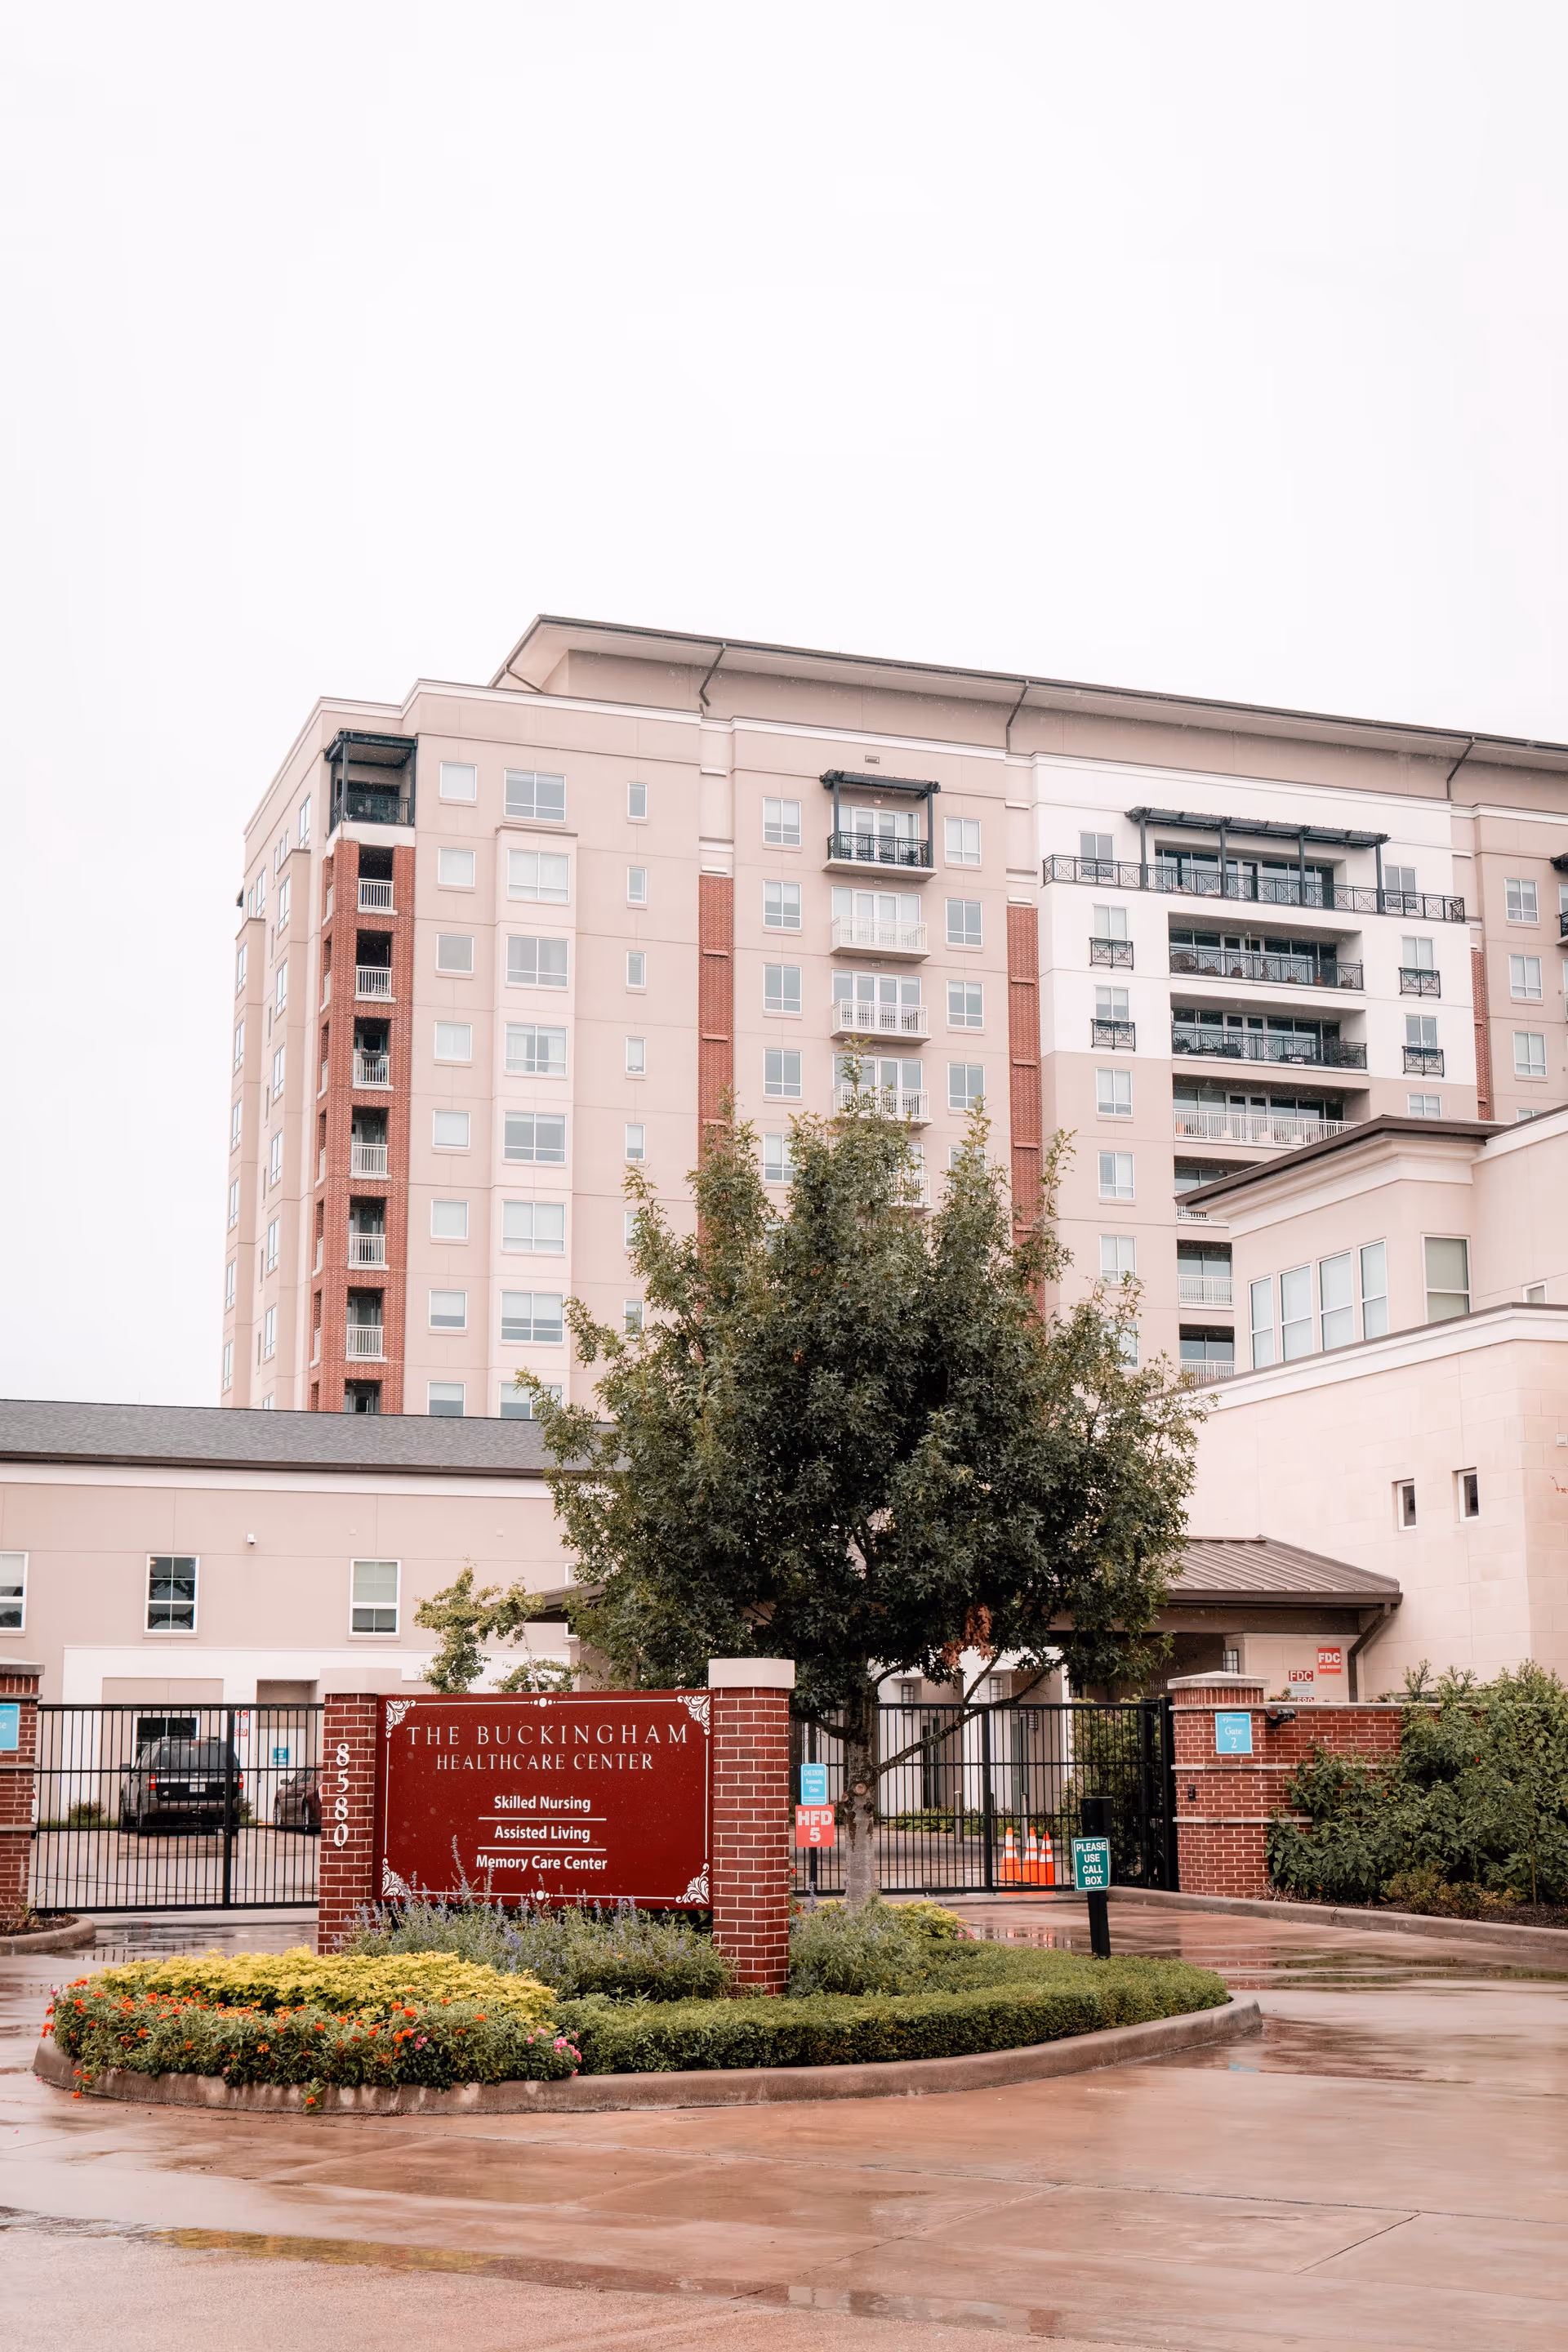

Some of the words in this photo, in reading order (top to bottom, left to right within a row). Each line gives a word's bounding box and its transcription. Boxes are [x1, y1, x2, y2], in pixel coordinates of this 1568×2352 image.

[1318, 1652, 1340, 1663] FDC
[1290, 1671, 1312, 1682] FDC
[407, 1726, 460, 1745] THE
[477, 1724, 688, 1744] BUCKINGHAM
[1225, 1726, 1243, 1735] Gate
[1231, 1737, 1237, 1748] 2
[437, 1753, 565, 1770] HEALTHCARE
[573, 1753, 653, 1770] CENTER
[333, 1743, 350, 1847] 8580
[494, 1795, 537, 1809] Skilled
[540, 1796, 590, 1812] Nursing
[797, 1811, 833, 1825] HFD
[494, 1825, 547, 1839] Assisted
[550, 1826, 590, 1843] Living
[809, 1827, 821, 1842] 5
[1076, 1842, 1106, 1852] PLEASE
[476, 1855, 528, 1872] Memory
[532, 1855, 560, 1869] Care
[564, 1856, 608, 1870] Center
[1084, 1854, 1100, 1863] USE
[1082, 1864, 1103, 1874] CALL
[1085, 1875, 1102, 1886] BOX
